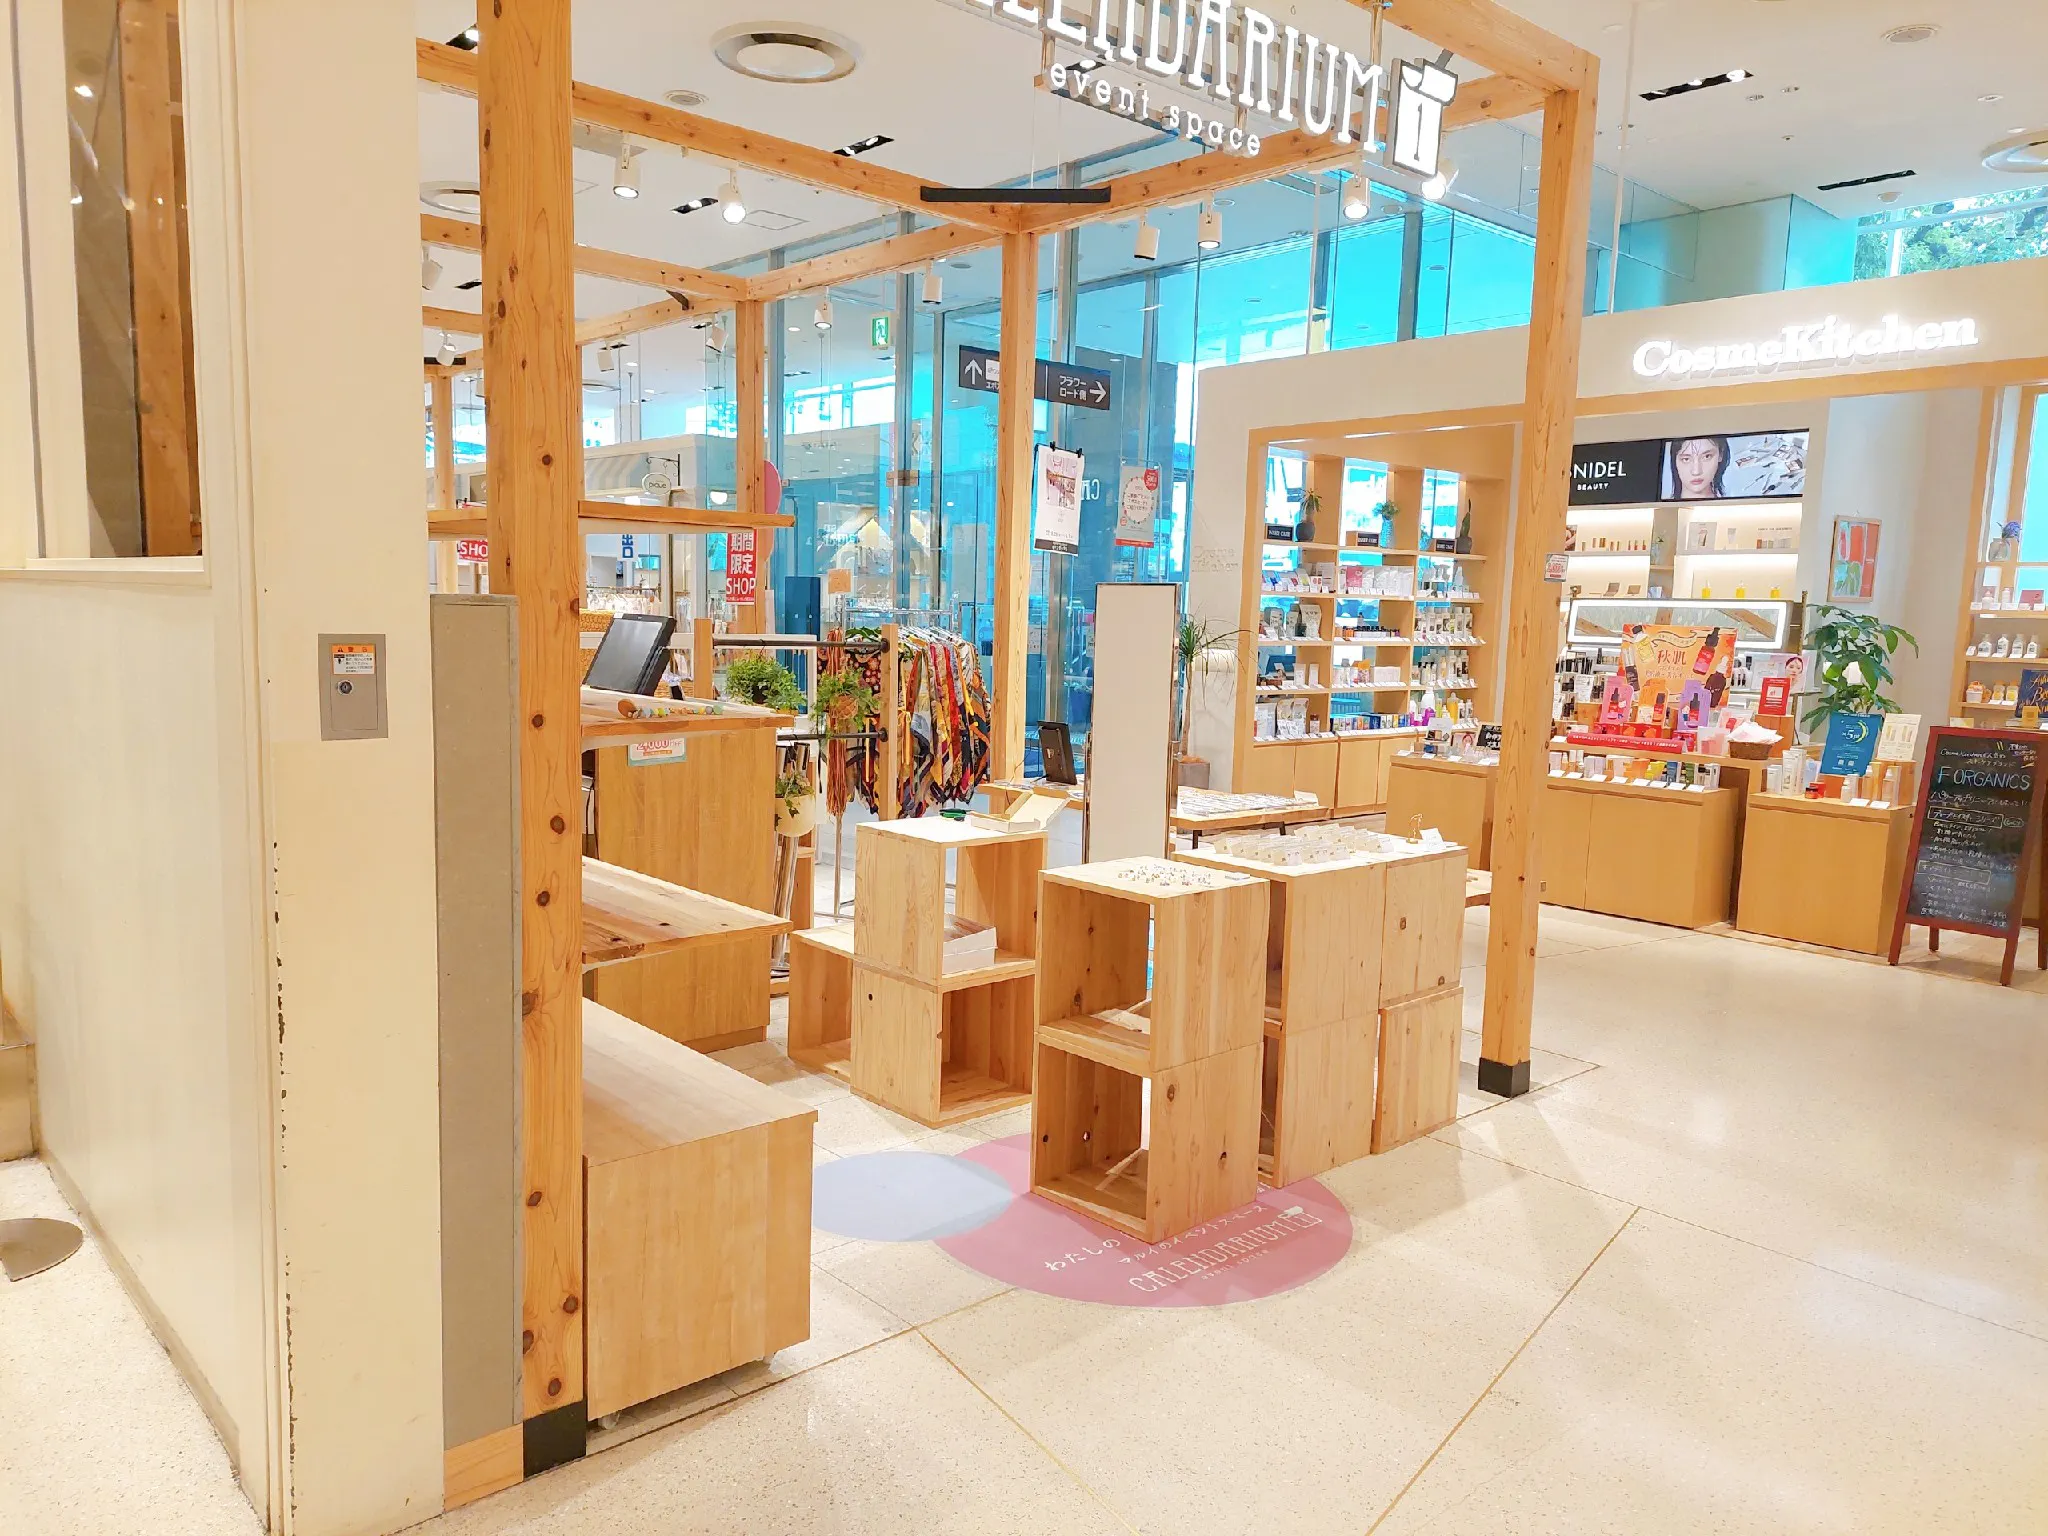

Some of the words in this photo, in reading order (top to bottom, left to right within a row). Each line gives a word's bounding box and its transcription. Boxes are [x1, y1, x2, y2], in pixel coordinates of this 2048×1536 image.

[1050, 62, 1150, 120] event
[1169, 104, 1261, 157] space
[1632, 314, 1980, 377] CosmeKitchen
[1570, 461, 1627, 479] NIDEL
[1577, 482, 1609, 491] BEAUTY
[621, 533, 634, 559] 出口
[731, 532, 754, 552] 期間
[730, 553, 753, 575] 限定
[726, 577, 756, 595] SHOP
[1937, 766, 1952, 784] F
[1953, 769, 2031, 791] ORGANICS
[1044, 1239, 1120, 1271] わたしの
